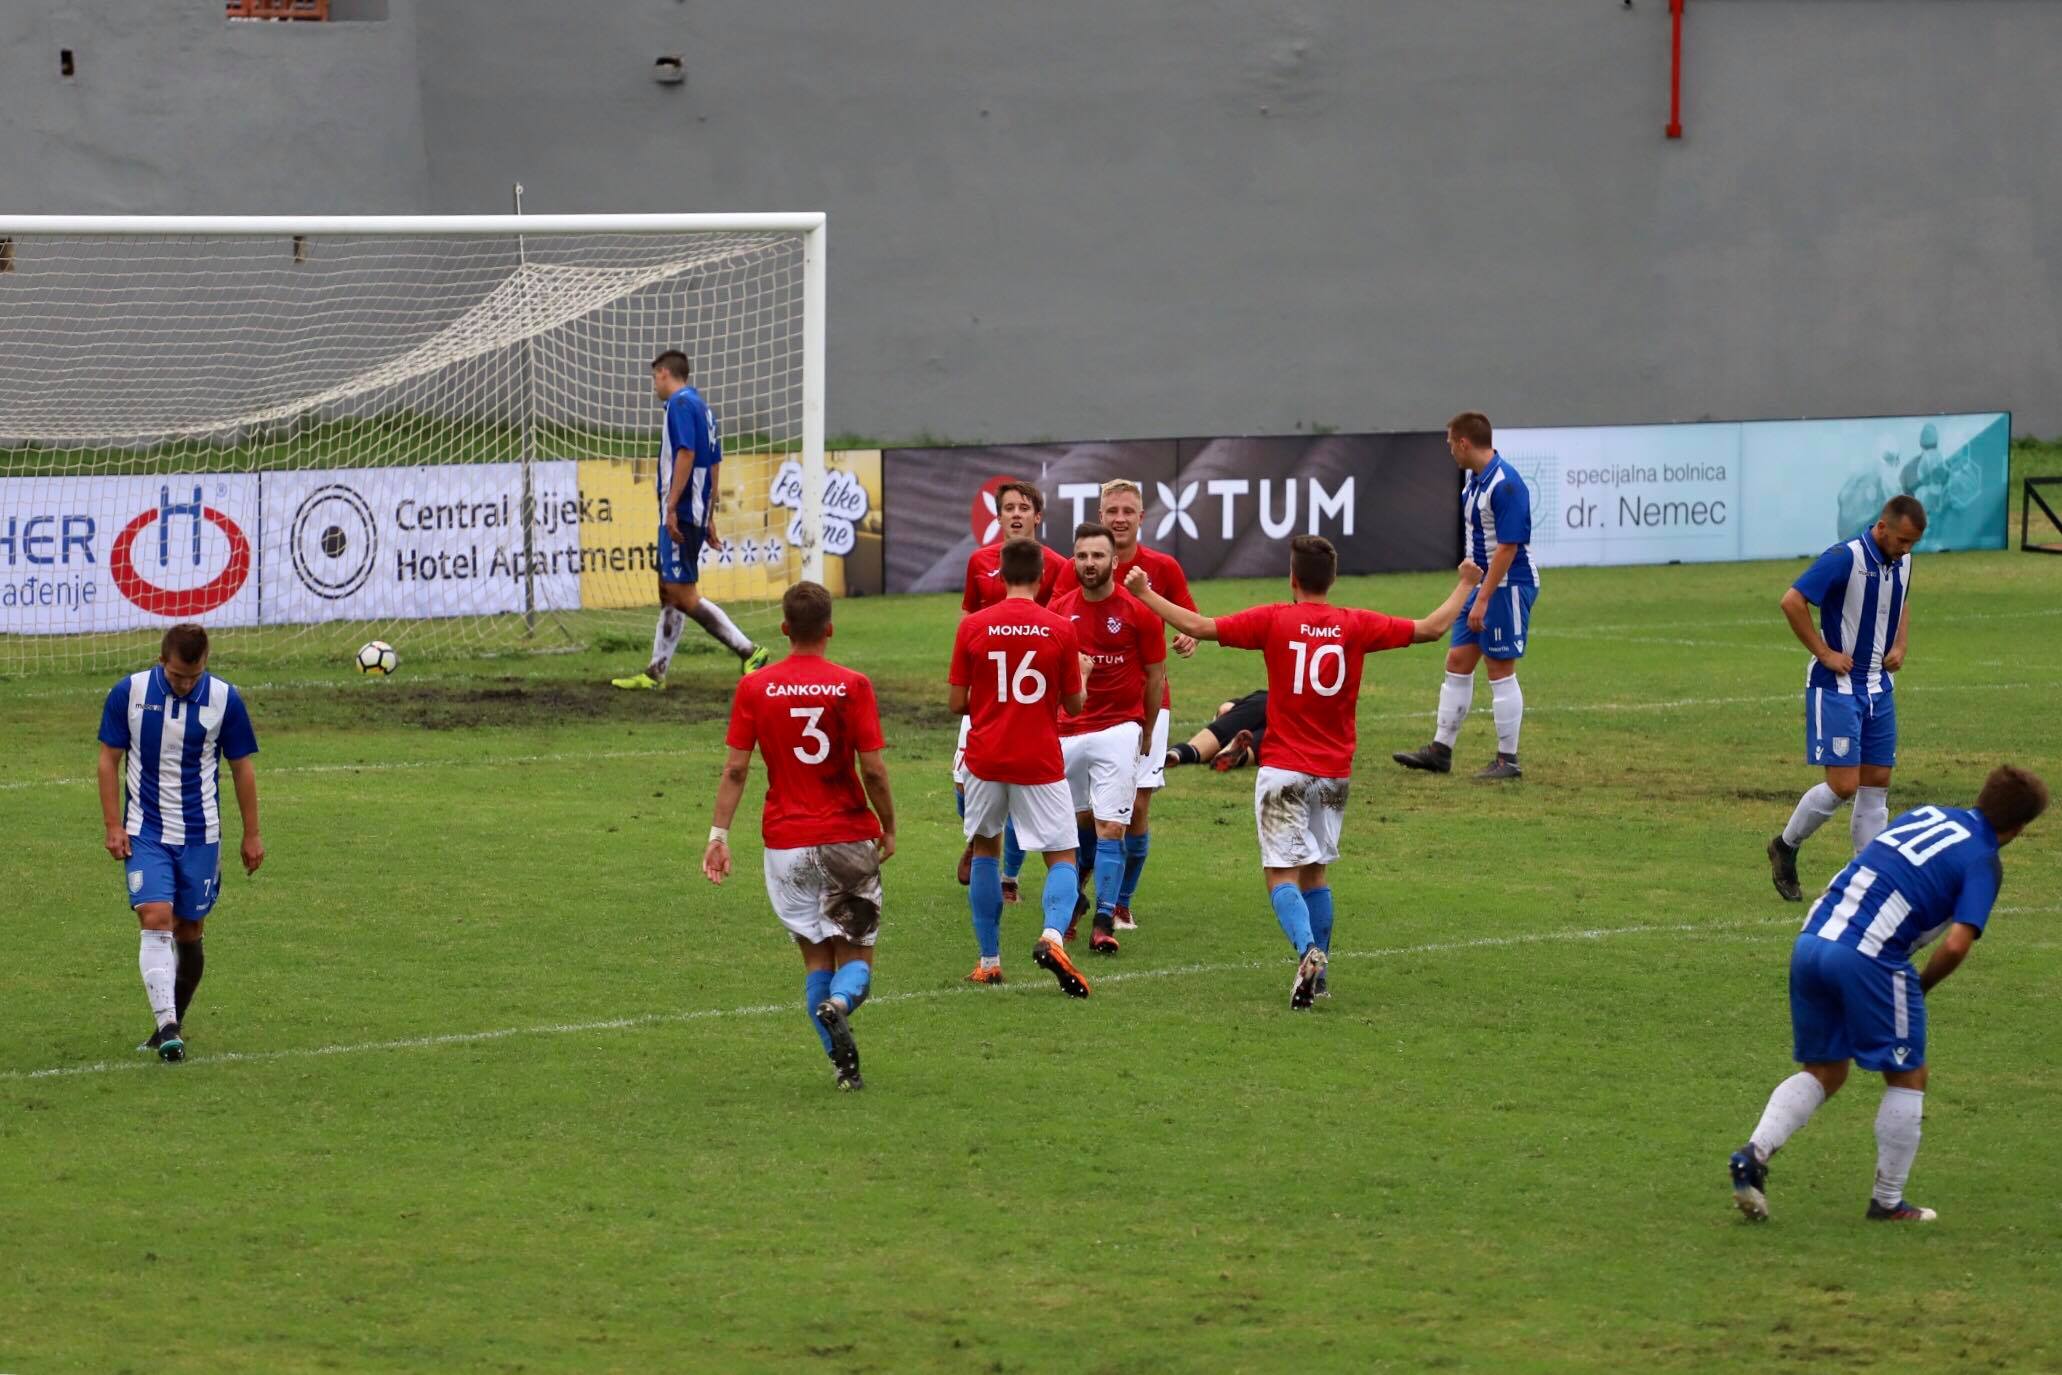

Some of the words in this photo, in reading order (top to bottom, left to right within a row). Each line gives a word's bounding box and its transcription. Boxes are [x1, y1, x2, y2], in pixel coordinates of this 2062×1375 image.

[1566, 464, 1657, 488] specijalna
[1663, 461, 1727, 482] bolnica
[394, 493, 509, 531] Central
[1058, 476, 1355, 540] TXTUM
[1566, 497, 1605, 529] dr.
[1618, 496, 1727, 527] Nemec
[396, 545, 478, 581] Hotel
[987, 625, 1050, 637] MONJAC
[1300, 623, 1343, 638] FUMIĆ
[987, 650, 1047, 704] 16
[1288, 640, 1346, 697] 10
[765, 682, 847, 697] ČANKOVIĆ
[789, 706, 831, 765] 3
[1875, 805, 1972, 867] 20
[204, 878, 212, 897] 7
